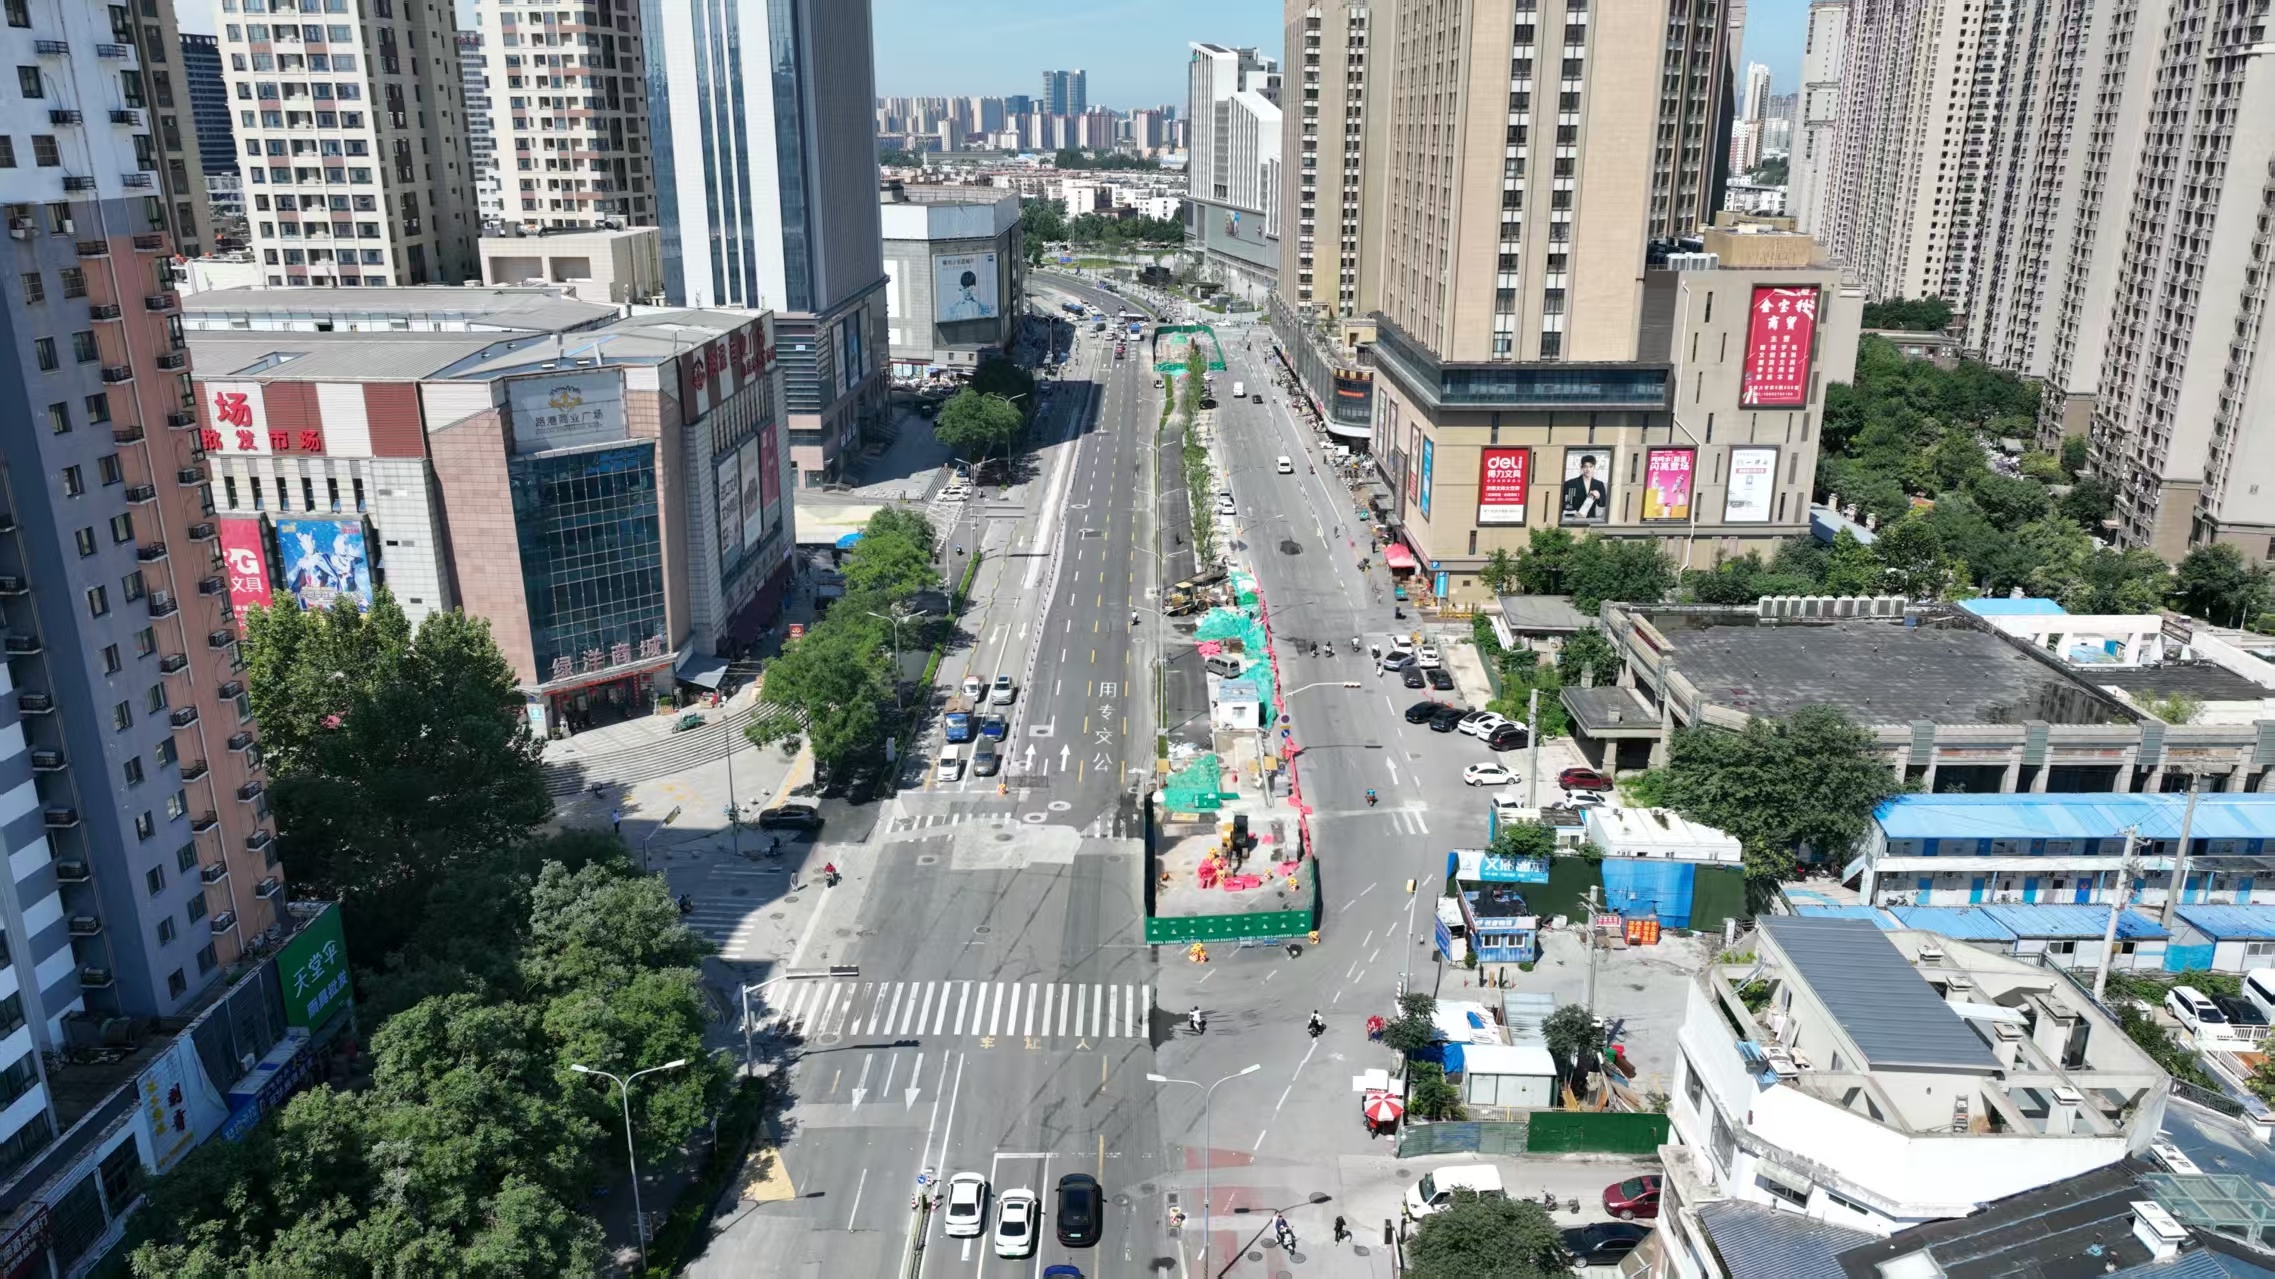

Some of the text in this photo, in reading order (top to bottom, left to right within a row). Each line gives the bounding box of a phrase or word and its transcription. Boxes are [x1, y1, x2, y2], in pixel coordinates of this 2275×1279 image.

[201, 428, 322, 452] 批发市场
[1487, 456, 1523, 470] deli
[1487, 469, 1521, 478] 得力文具
[551, 634, 662, 680] 绿洋商城
[293, 940, 338, 998] 天堂伞
